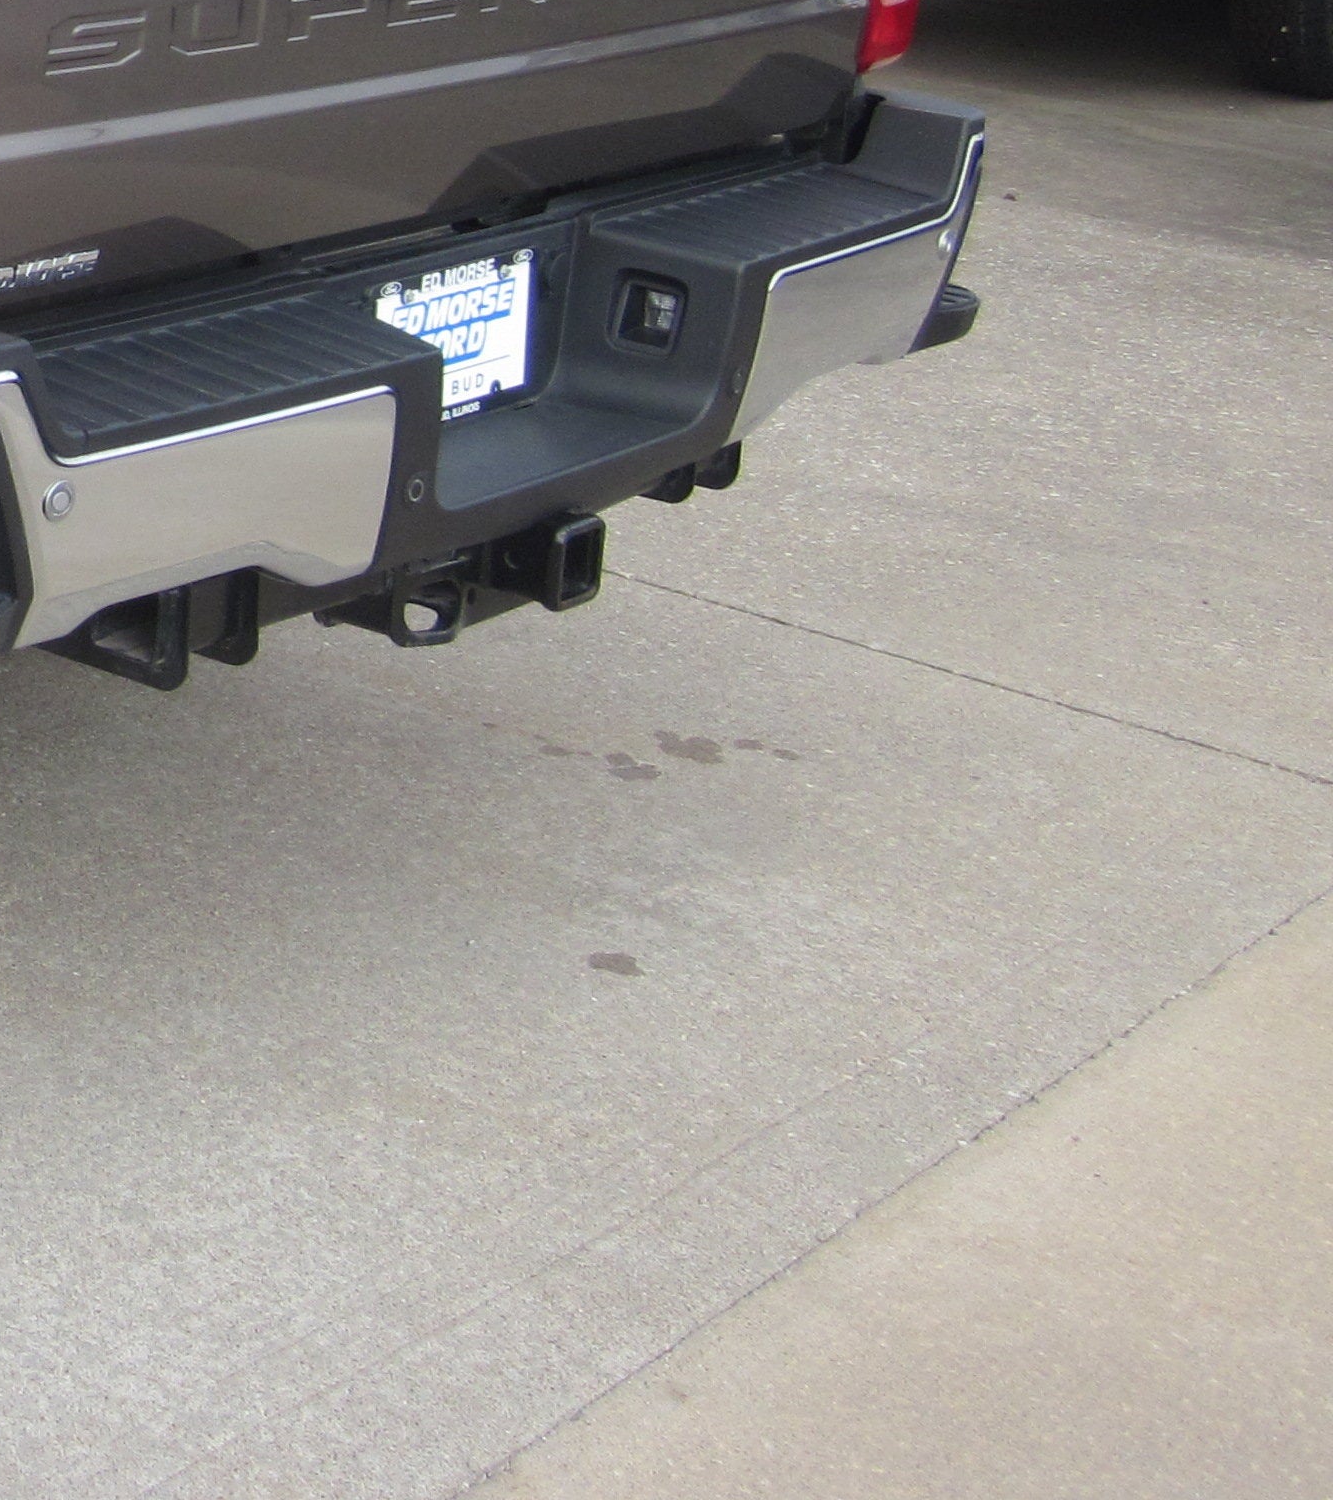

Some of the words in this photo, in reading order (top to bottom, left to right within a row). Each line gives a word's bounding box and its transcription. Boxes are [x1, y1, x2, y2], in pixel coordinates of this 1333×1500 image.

[421, 273, 441, 292] ED
[444, 258, 496, 288] MORSE
[391, 302, 428, 336] ED
[426, 278, 516, 330] MORSE
[421, 321, 487, 361] ORD
[452, 373, 484, 395] BUD
